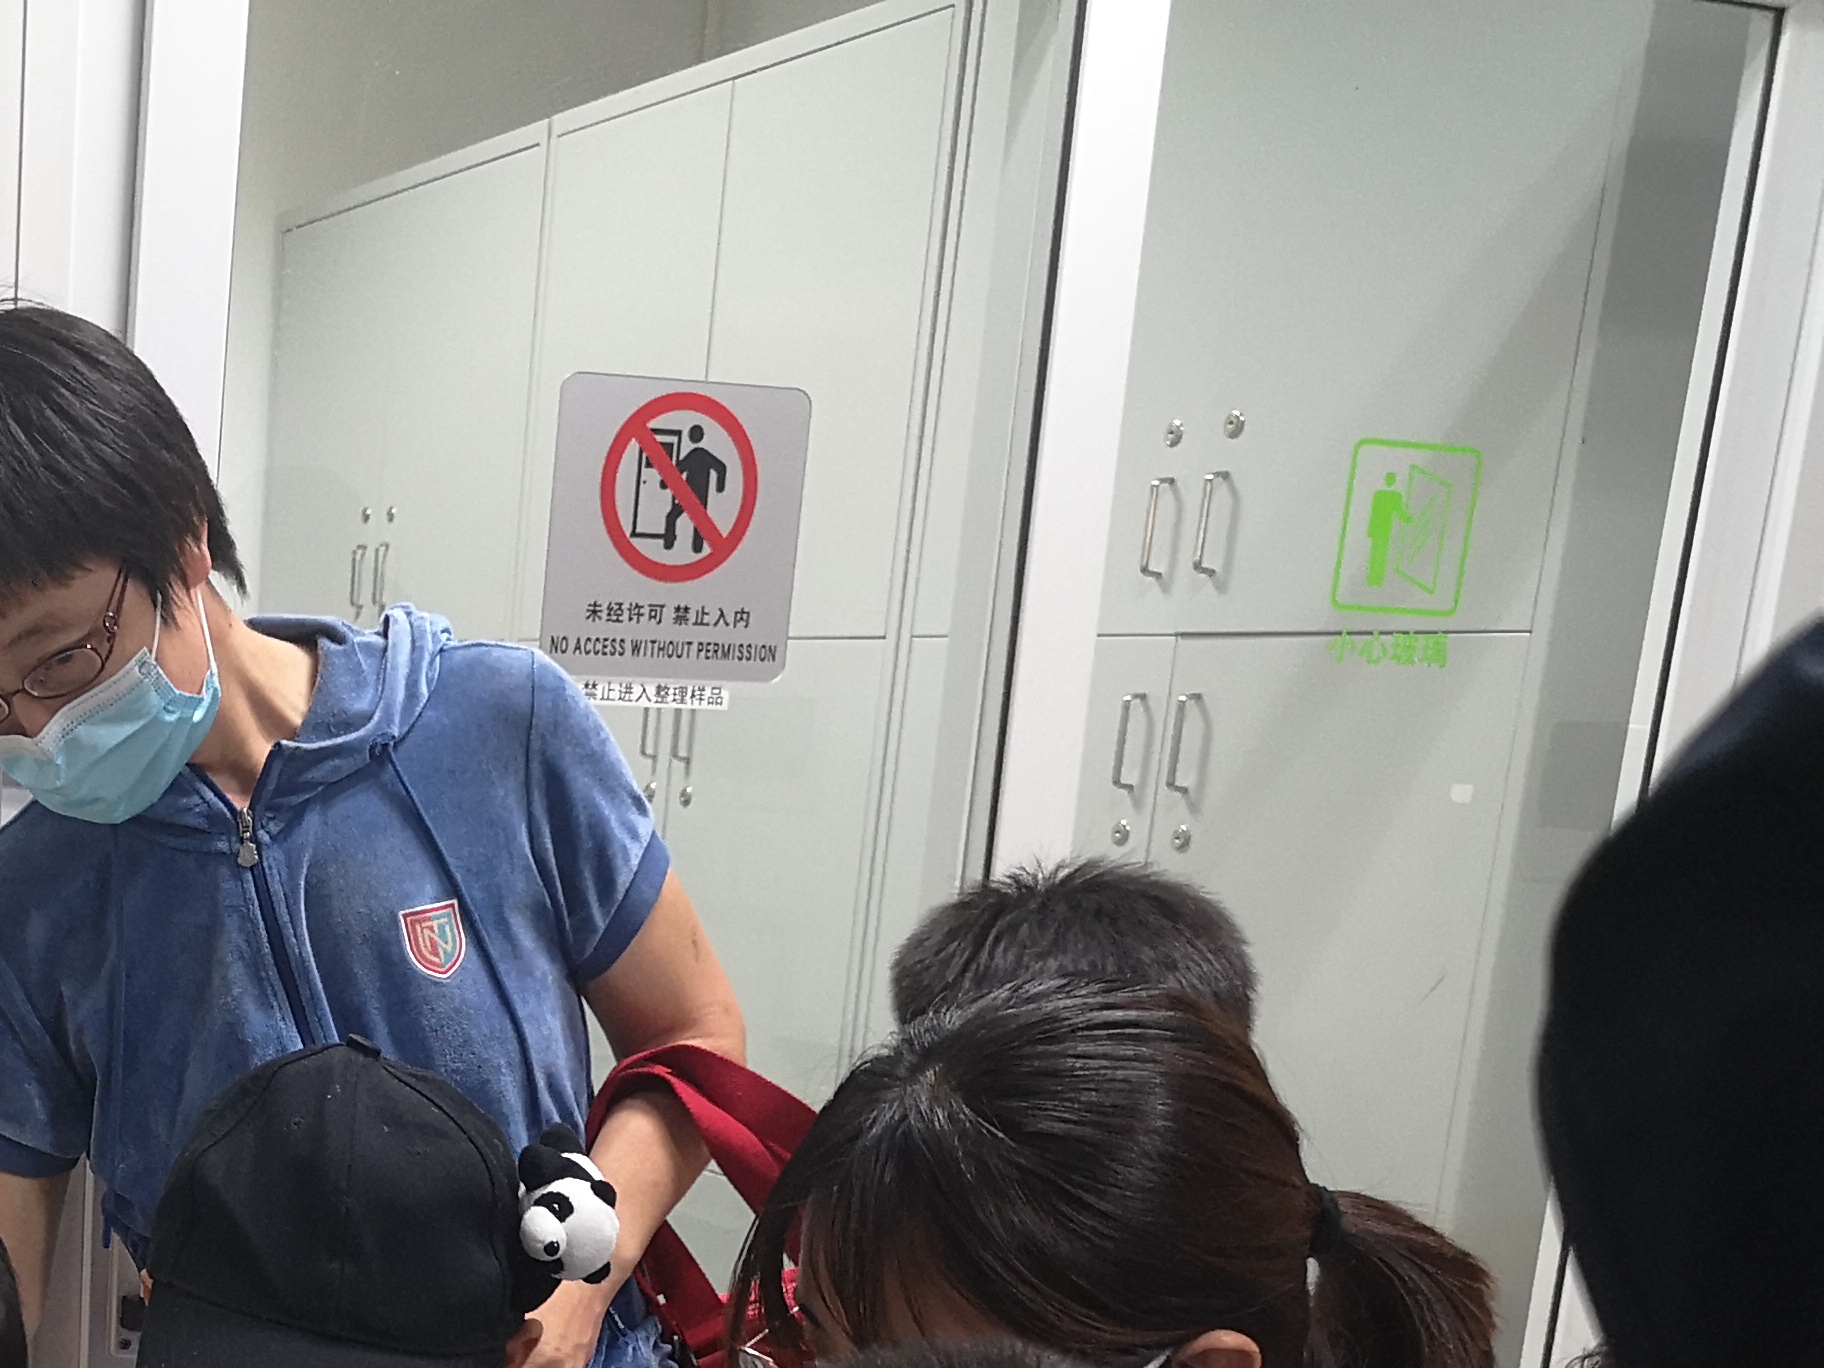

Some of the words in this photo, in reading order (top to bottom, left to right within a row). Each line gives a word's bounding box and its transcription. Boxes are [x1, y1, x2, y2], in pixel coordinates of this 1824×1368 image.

[585, 601, 666, 625] 未经许可
[672, 604, 751, 629] 禁止入内
[549, 635, 568, 654] NO
[573, 637, 626, 656] ACCESS
[630, 639, 693, 659] WITHOUT
[696, 641, 777, 662] PERMISSION
[1329, 628, 1449, 668] 小心玻璃
[581, 680, 724, 706] 禁止进入整理样品
